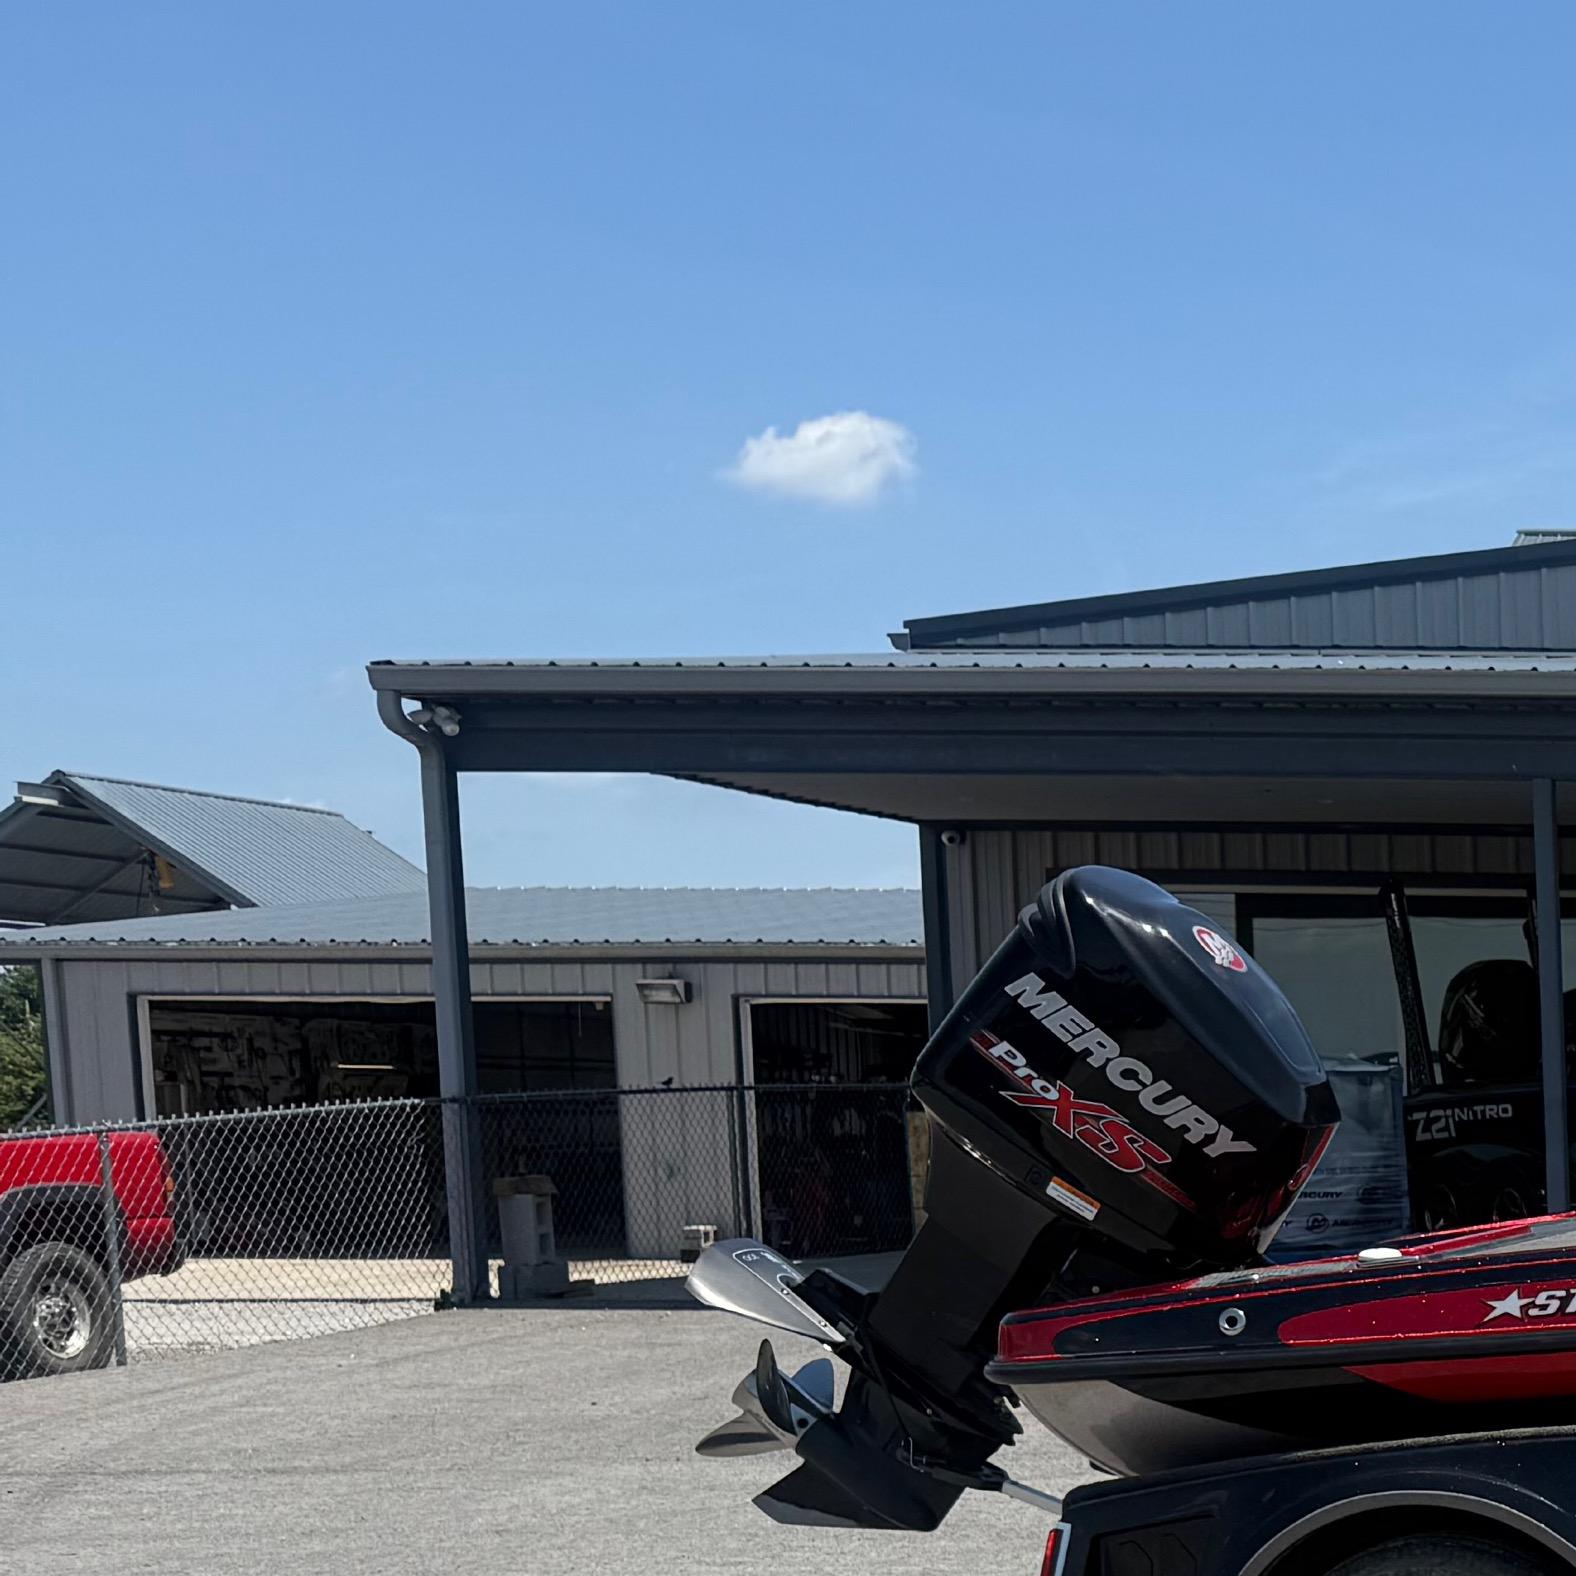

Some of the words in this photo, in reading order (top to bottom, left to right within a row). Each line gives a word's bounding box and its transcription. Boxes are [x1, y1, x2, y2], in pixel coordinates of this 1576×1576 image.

[989, 1041, 1060, 1101] Pro
[1004, 971, 1258, 1159] MERCURY
[998, 1080, 1173, 1173] XS
